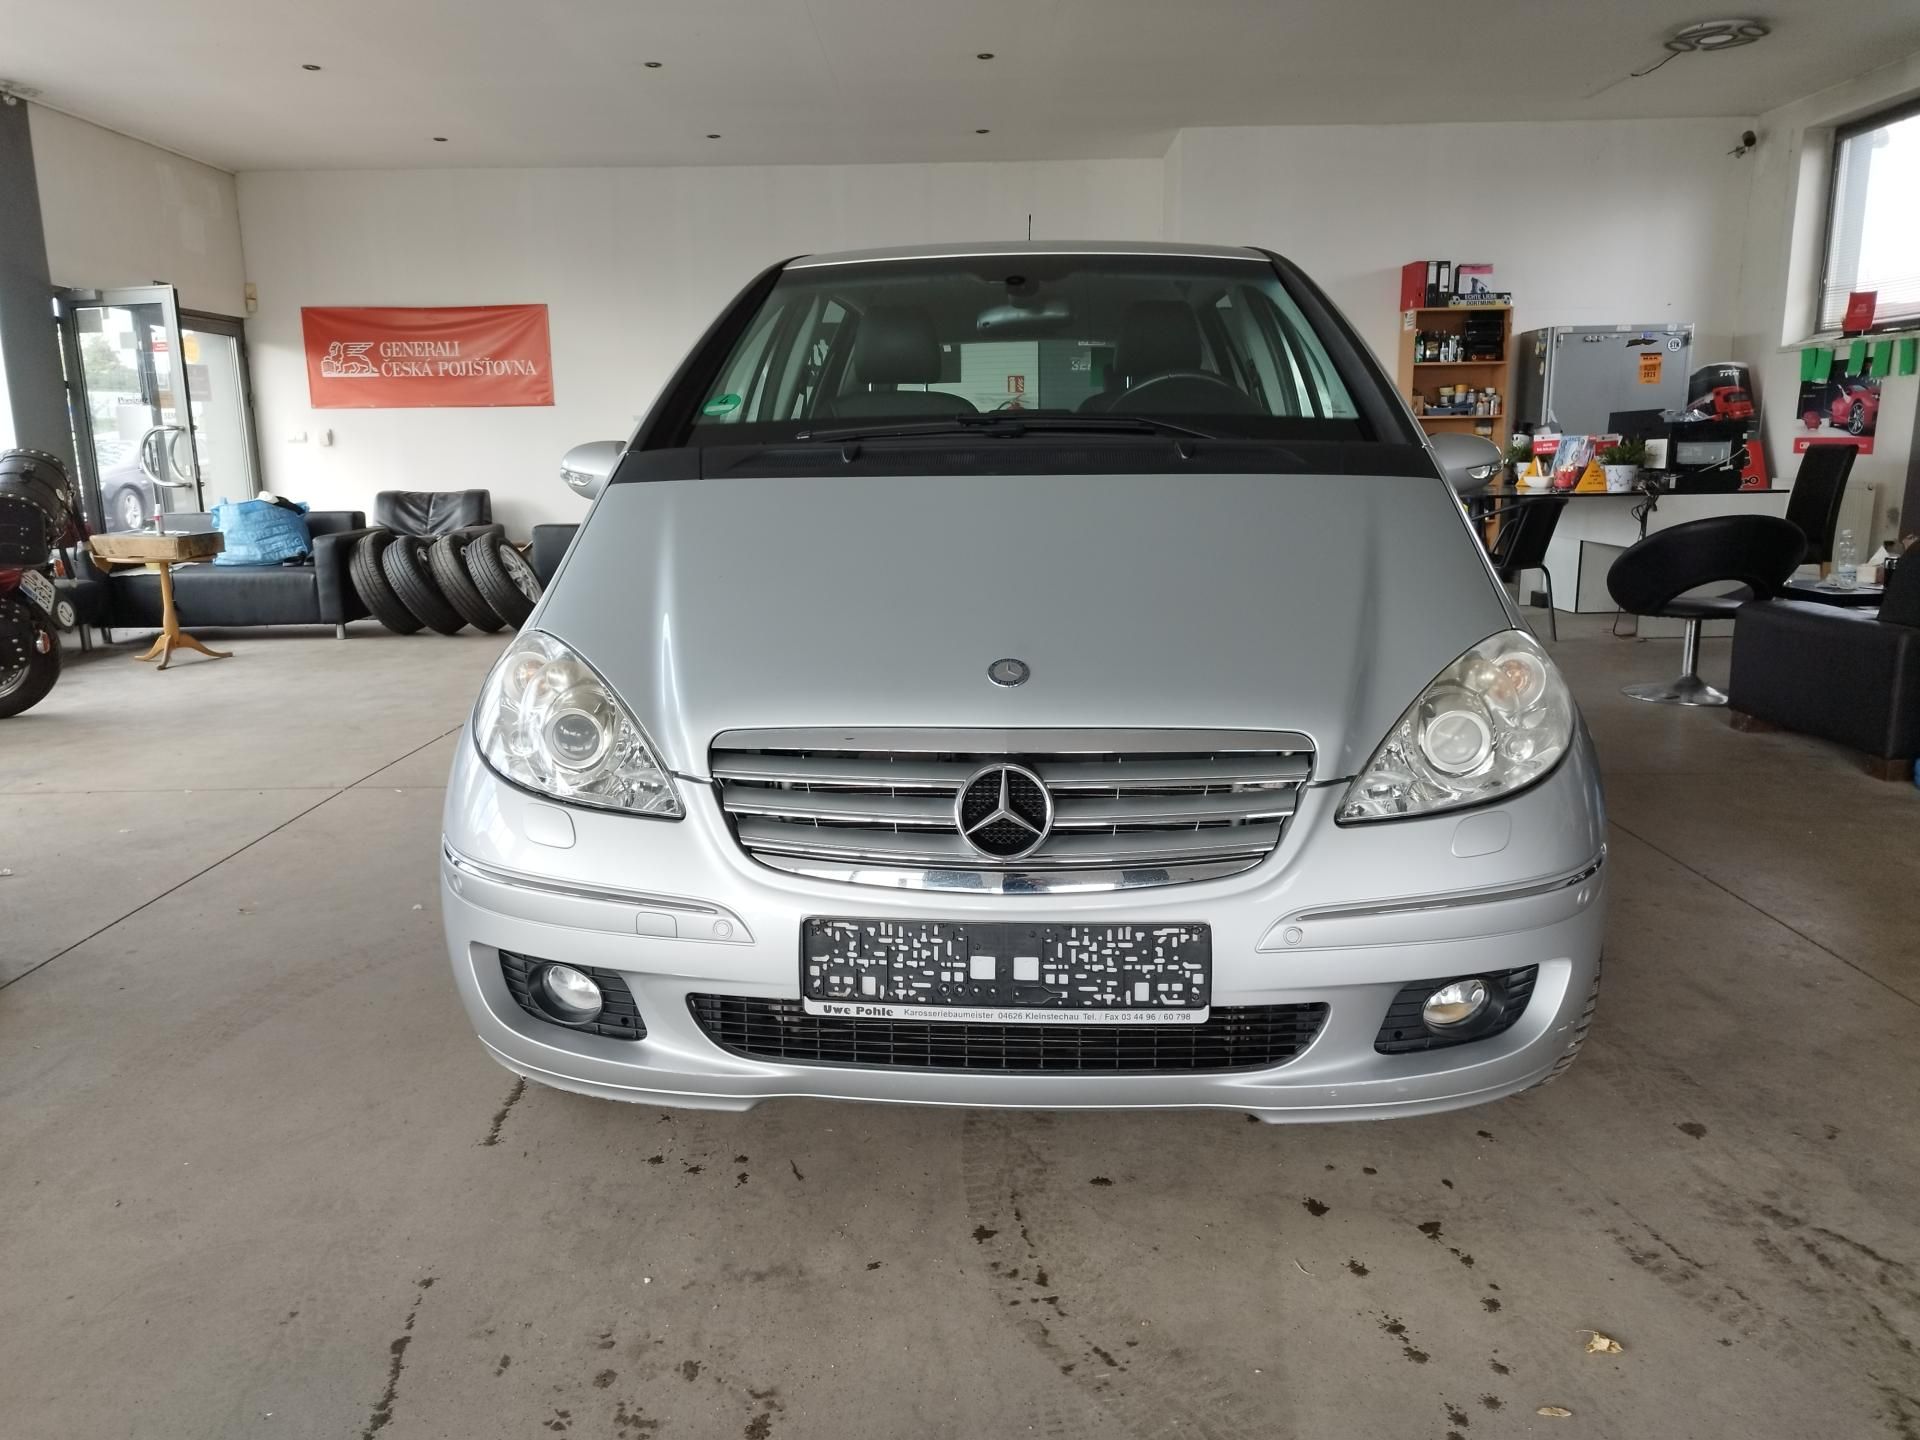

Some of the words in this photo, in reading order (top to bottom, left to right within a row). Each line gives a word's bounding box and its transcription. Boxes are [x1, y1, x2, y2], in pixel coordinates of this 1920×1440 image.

[380, 341, 460, 357] GENERALI
[381, 358, 434, 377] ČESKÁ
[438, 357, 538, 377] POJIŠŤOVNA
[718, 396, 729, 405] 4
[823, 1004, 851, 1015] Uwe
[855, 1006, 894, 1017] Pohle
[904, 1008, 994, 1019] Karosseriebaumeister
[998, 1012, 1023, 1020] 04626
[1025, 1013, 1079, 1021] Kleinstechau
[1083, 1013, 1097, 1021] Tel.
[1104, 1013, 1119, 1021] Fax
[1121, 1013, 1132, 1021] 03
[1133, 1013, 1144, 1021] 44
[1146, 1013, 1156, 1021] 96
[1163, 1013, 1174, 1021] 60
[1176, 1013, 1192, 1021] 798
